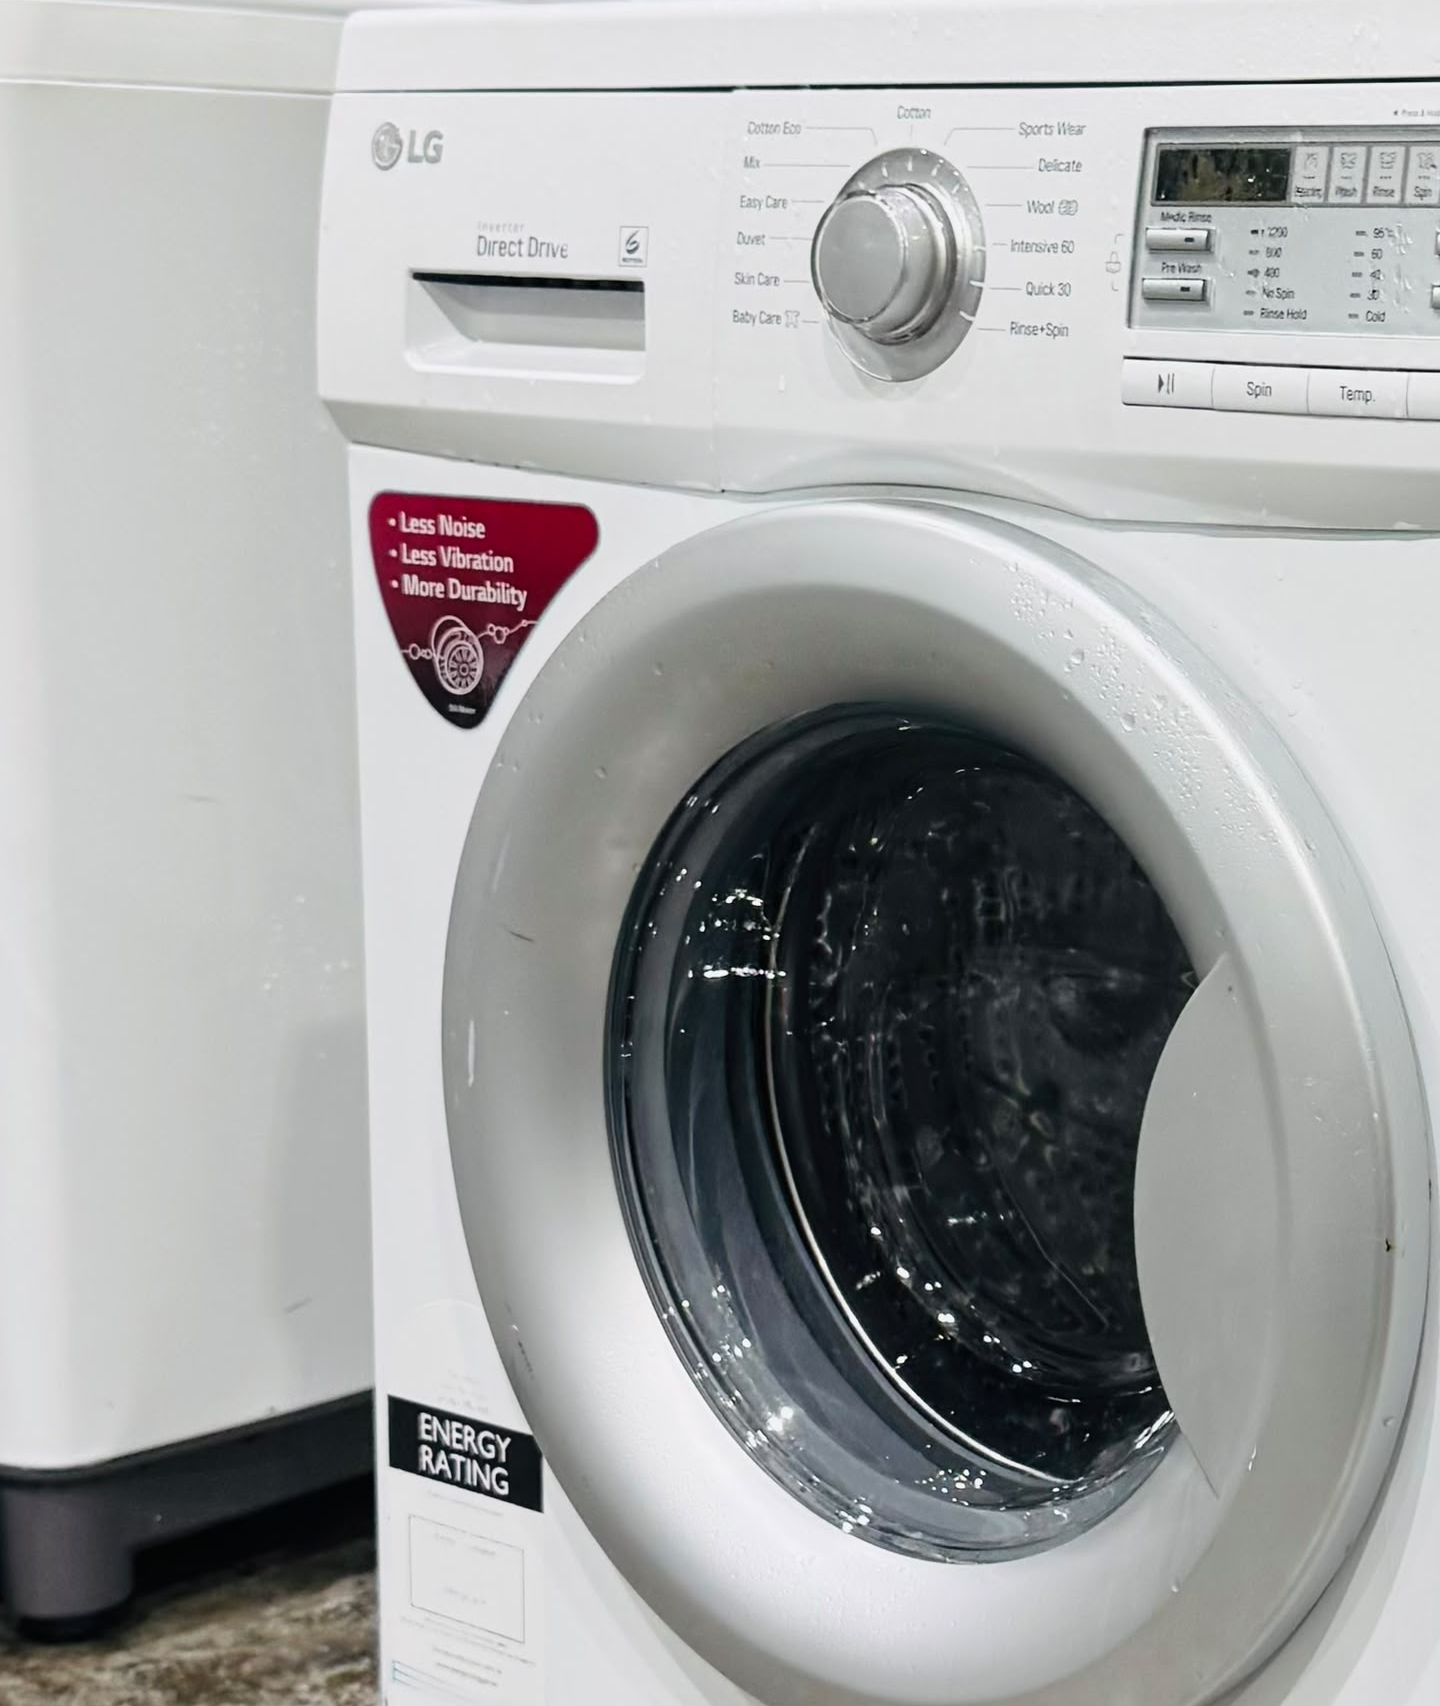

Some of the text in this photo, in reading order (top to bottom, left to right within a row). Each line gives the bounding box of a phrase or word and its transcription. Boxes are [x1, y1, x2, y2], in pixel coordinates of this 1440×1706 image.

[897, 106, 931, 120] Cotton
[747, 121, 801, 135] Cotton Eco
[1019, 122, 1086, 138] Sports Wear
[407, 130, 443, 164] LG
[744, 155, 760, 169] Mix
[1038, 158, 1082, 173] Delicate
[740, 195, 787, 211] Easy Care
[1027, 200, 1055, 214] Wool
[477, 221, 525, 233] Inverter
[737, 231, 766, 246] Duvet
[1011, 239, 1075, 254] Intensive 60
[476, 235, 569, 259] Direct Drive
[1161, 262, 1175, 273] Pre
[734, 272, 780, 287] Skin Care
[1026, 281, 1072, 297] Quick 30
[1276, 288, 1295, 300] Spin
[732, 309, 782, 327] Baby Care
[1259, 307, 1307, 320] Rinse Hold
[1365, 310, 1386, 323] Cold
[1009, 321, 1069, 340] Rinse+Spin
[1246, 381, 1272, 399] Spin
[1339, 386, 1376, 405] Temp.
[399, 511, 486, 539] Less Noise
[401, 543, 514, 574] Less Vibration
[401, 574, 528, 612] More Durability
[417, 1411, 512, 1464] ENERGY
[418, 1444, 510, 1496] RATING
